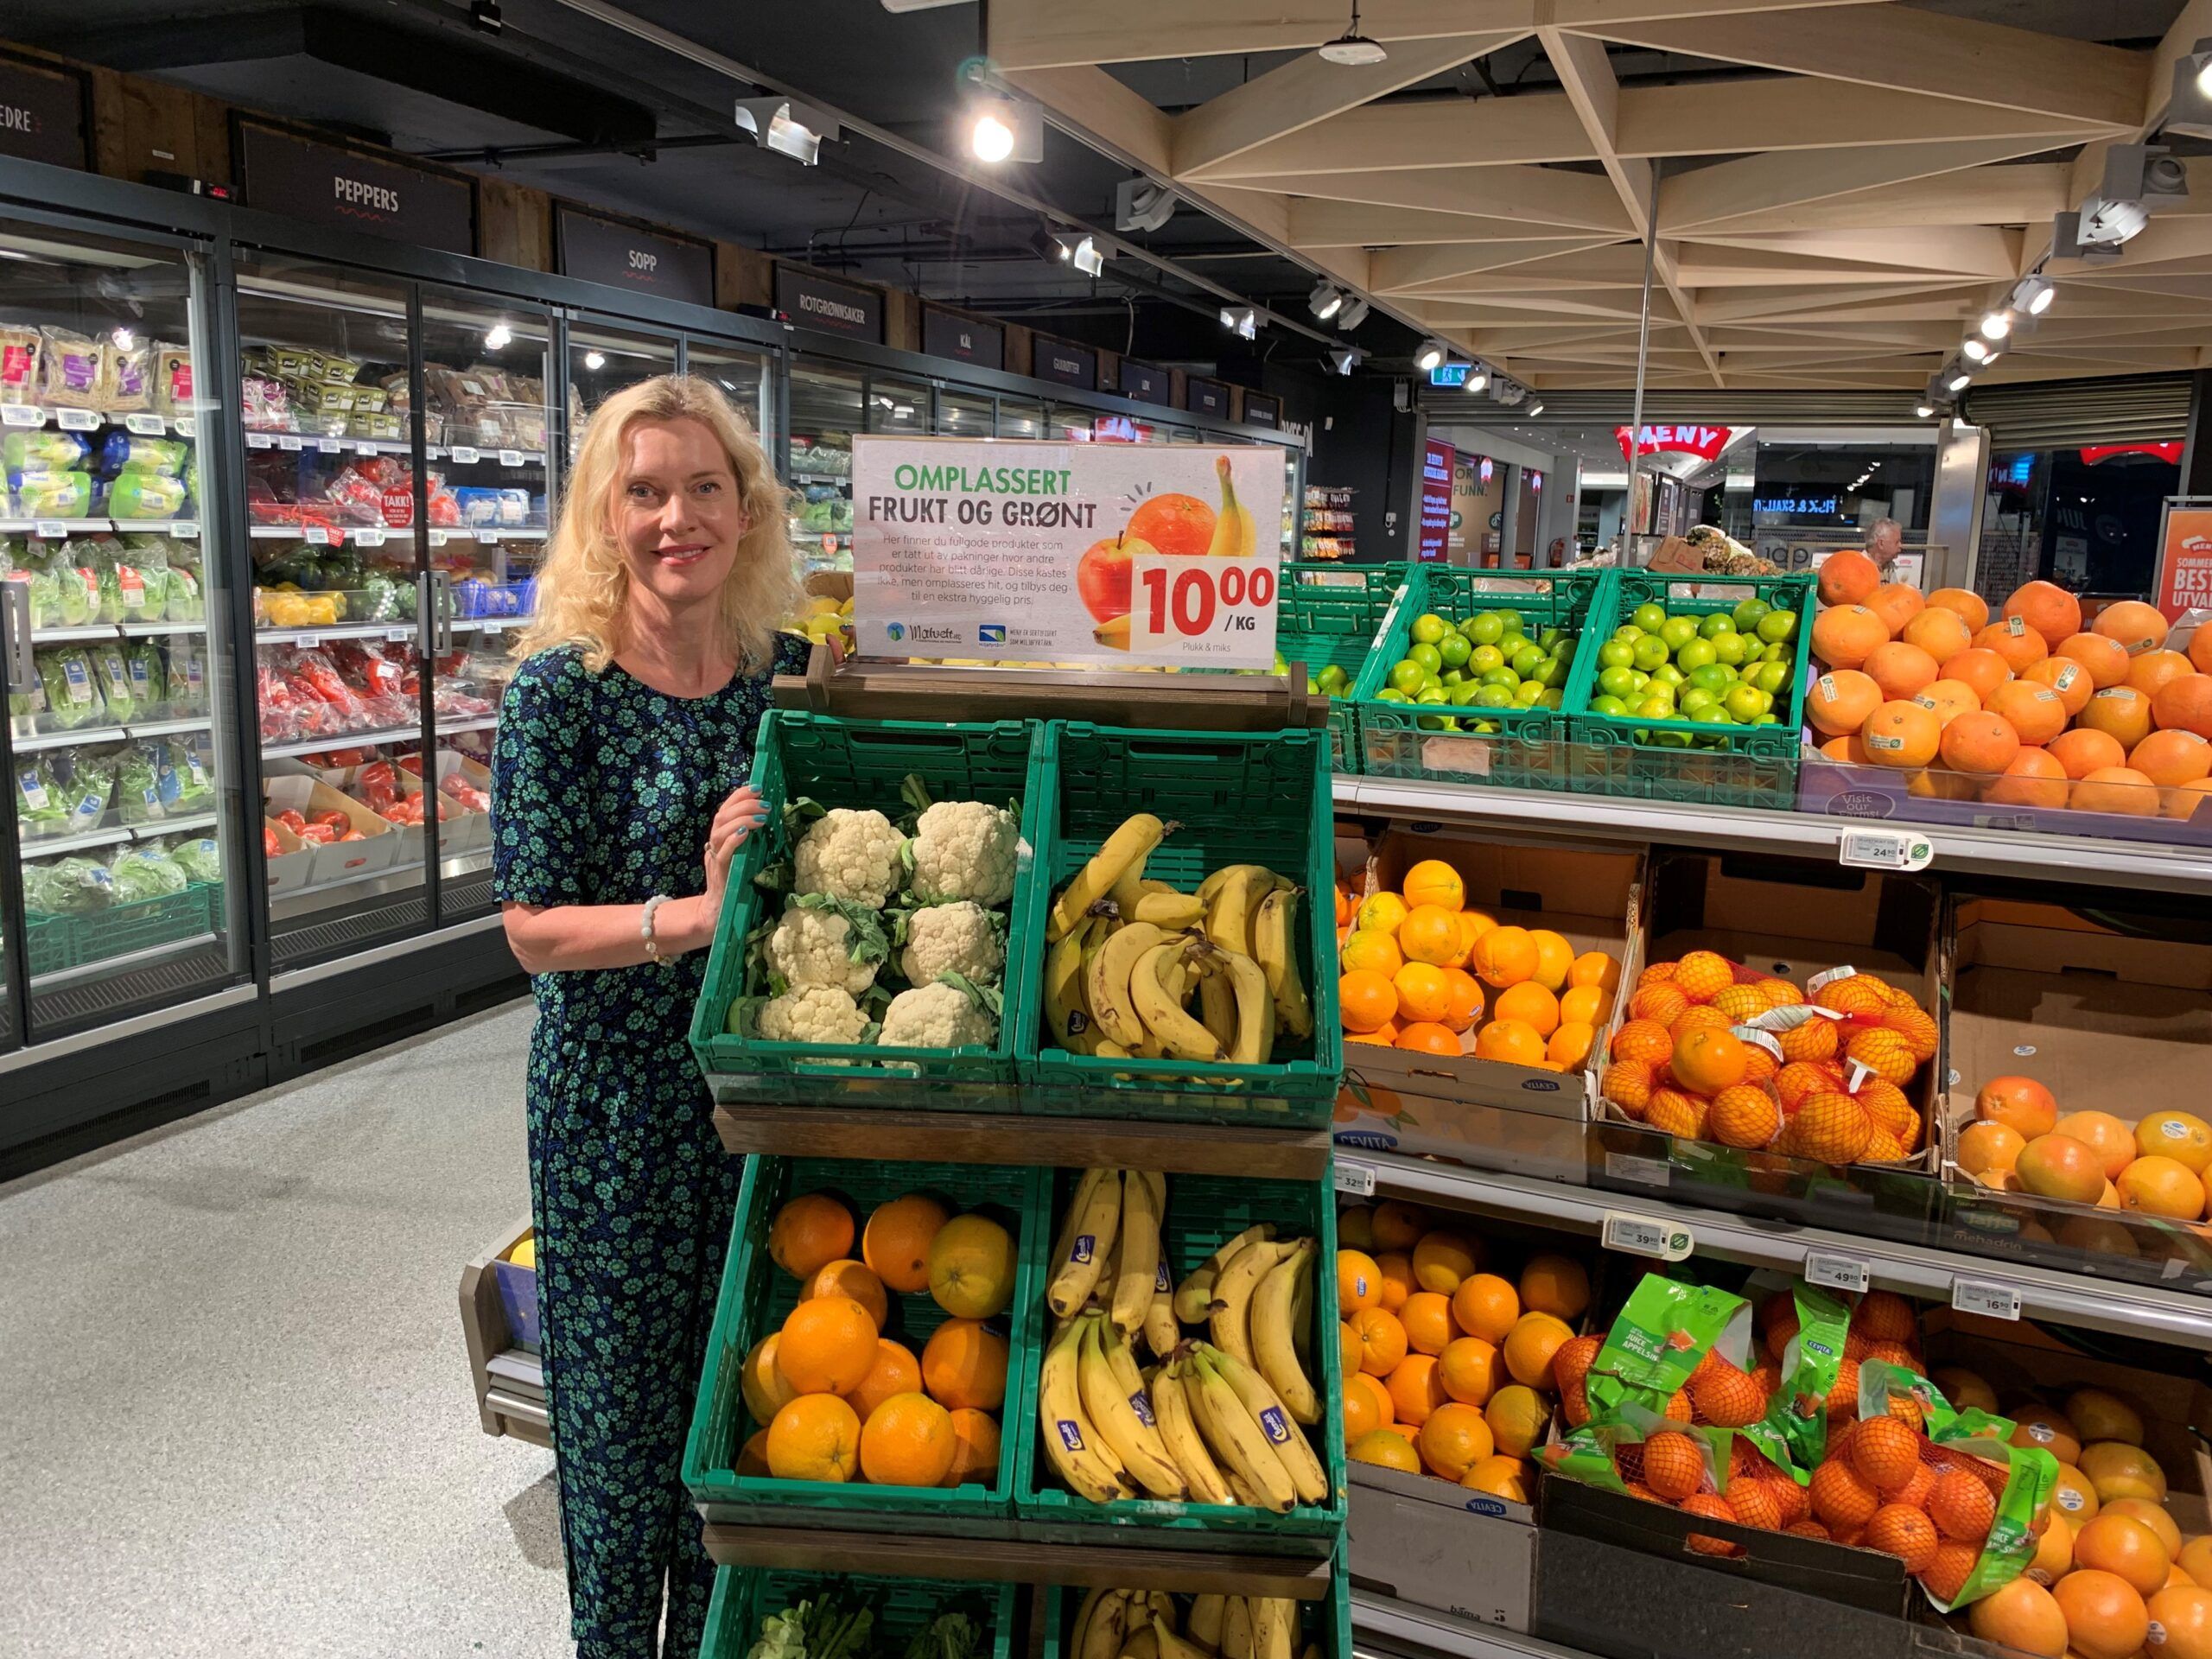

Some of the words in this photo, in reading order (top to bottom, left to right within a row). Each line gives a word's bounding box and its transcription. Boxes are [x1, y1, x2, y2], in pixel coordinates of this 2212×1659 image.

[334, 176, 399, 213] PEPPERS
[629, 250, 657, 271] SOPP
[799, 294, 865, 324] ROTGRØNNSAKER
[960, 334, 971, 348] KÅL
[1627, 426, 1718, 448] MENY
[894, 465, 1071, 495] OMPLASSERT
[384, 495, 410, 507] TAKK!
[869, 496, 948, 523] FRUKT
[958, 499, 992, 525] OG
[1002, 501, 1096, 528] GRØNT
[884, 535, 900, 544] Her
[903, 536, 931, 546] finner
[934, 537, 947, 546] du
[950, 537, 989, 550] fullgode
[992, 538, 1039, 550] produkter
[905, 550, 922, 559] tatt
[925, 551, 935, 560] ut
[951, 552, 999, 563] pakninger
[1002, 553, 1024, 563] hvor
[1027, 555, 1054, 563] andre
[879, 563, 927, 575] produkter
[930, 564, 945, 575] har
[948, 565, 967, 575] blitt
[970, 565, 1005, 576] dårlige.
[1008, 568, 1033, 577] Disse
[1037, 569, 1066, 578] kastes
[901, 578, 923, 587] men
[925, 579, 985, 590] omplasseres
[988, 580, 1003, 590] hit,
[1006, 582, 1018, 593] og
[1020, 582, 1046, 593] tilbys
[1049, 582, 1068, 594] deg
[912, 591, 920, 600] til
[938, 593, 967, 602] ekstra
[969, 593, 1011, 605] hyggelig
[1014, 595, 1033, 605] pris.
[1183, 642, 1204, 652] Plukk
[1205, 643, 1211, 652] &
[1212, 644, 1230, 652] miks
[1841, 794, 1872, 804] Visit
[1625, 1332, 1647, 1346] JUICE
